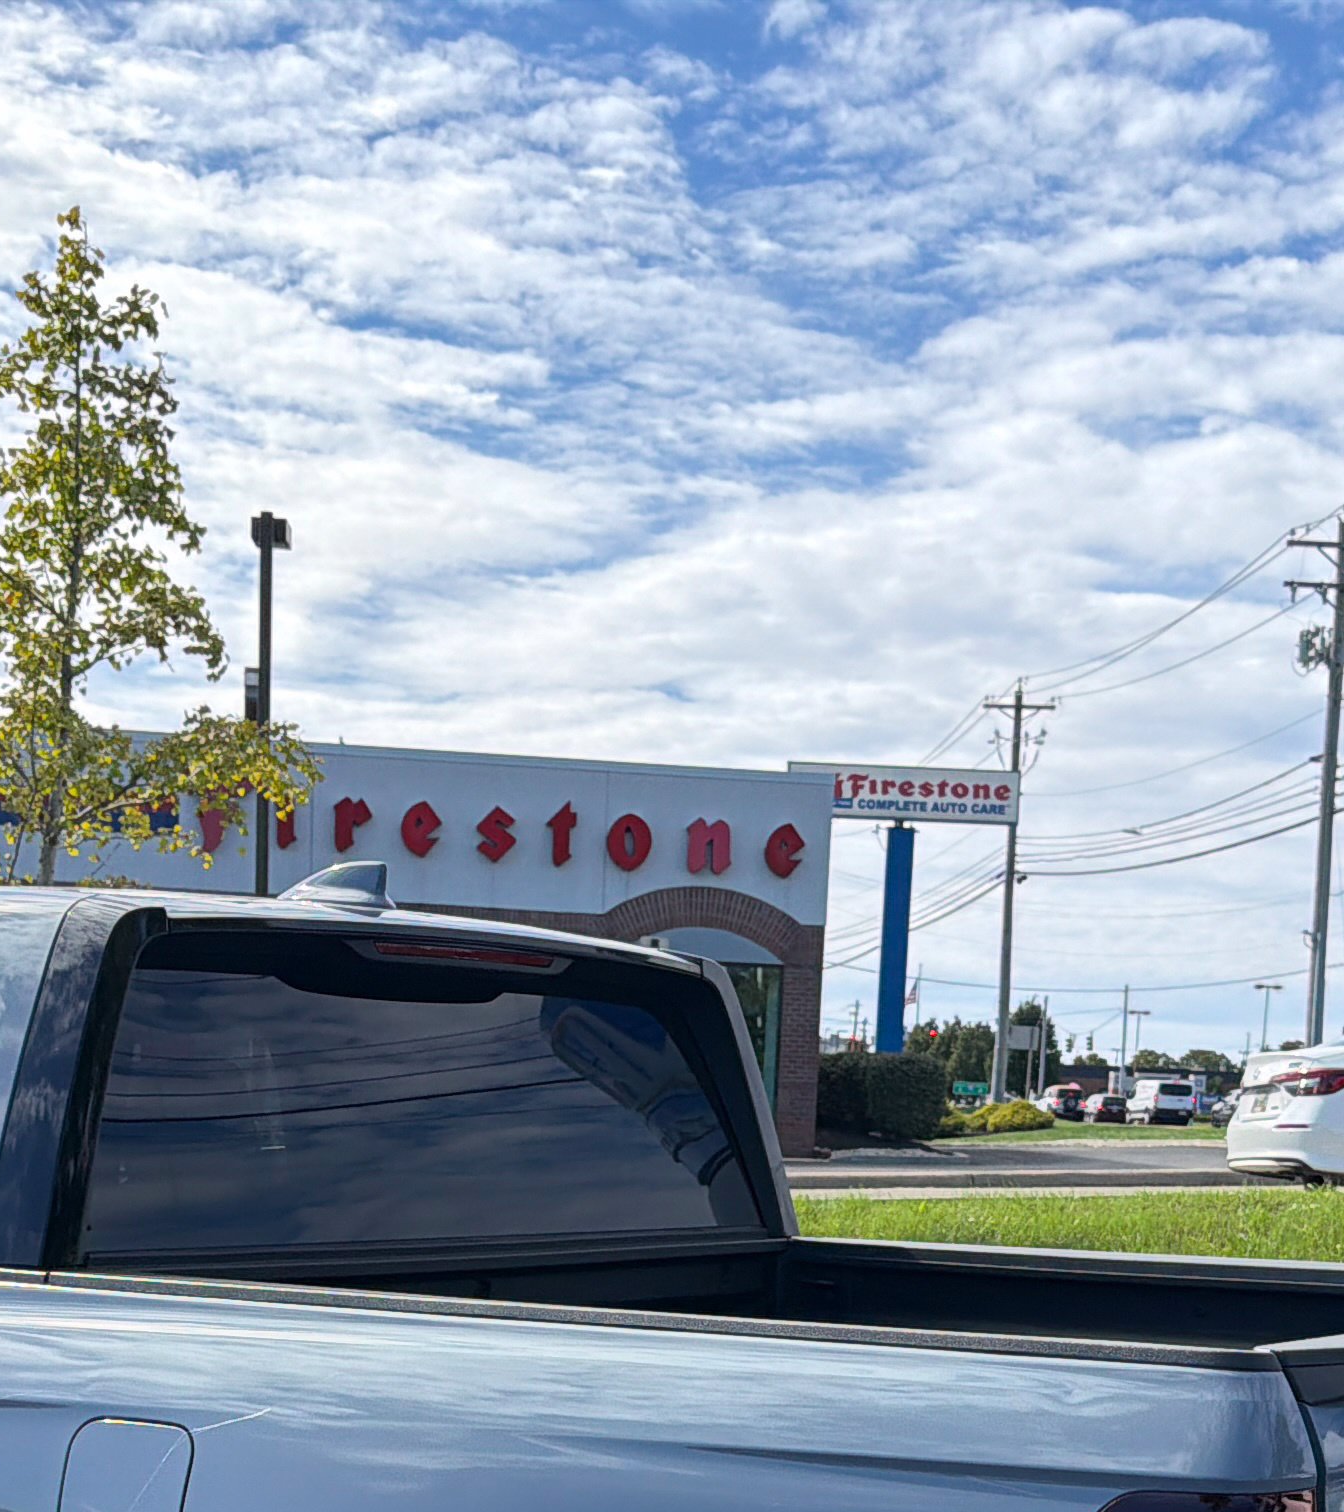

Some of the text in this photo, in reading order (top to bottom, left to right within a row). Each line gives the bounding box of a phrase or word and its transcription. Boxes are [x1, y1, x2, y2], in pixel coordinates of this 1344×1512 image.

[846, 773, 1012, 801] Firestone
[857, 798, 1006, 816] COMPLETE AUTO CARE
